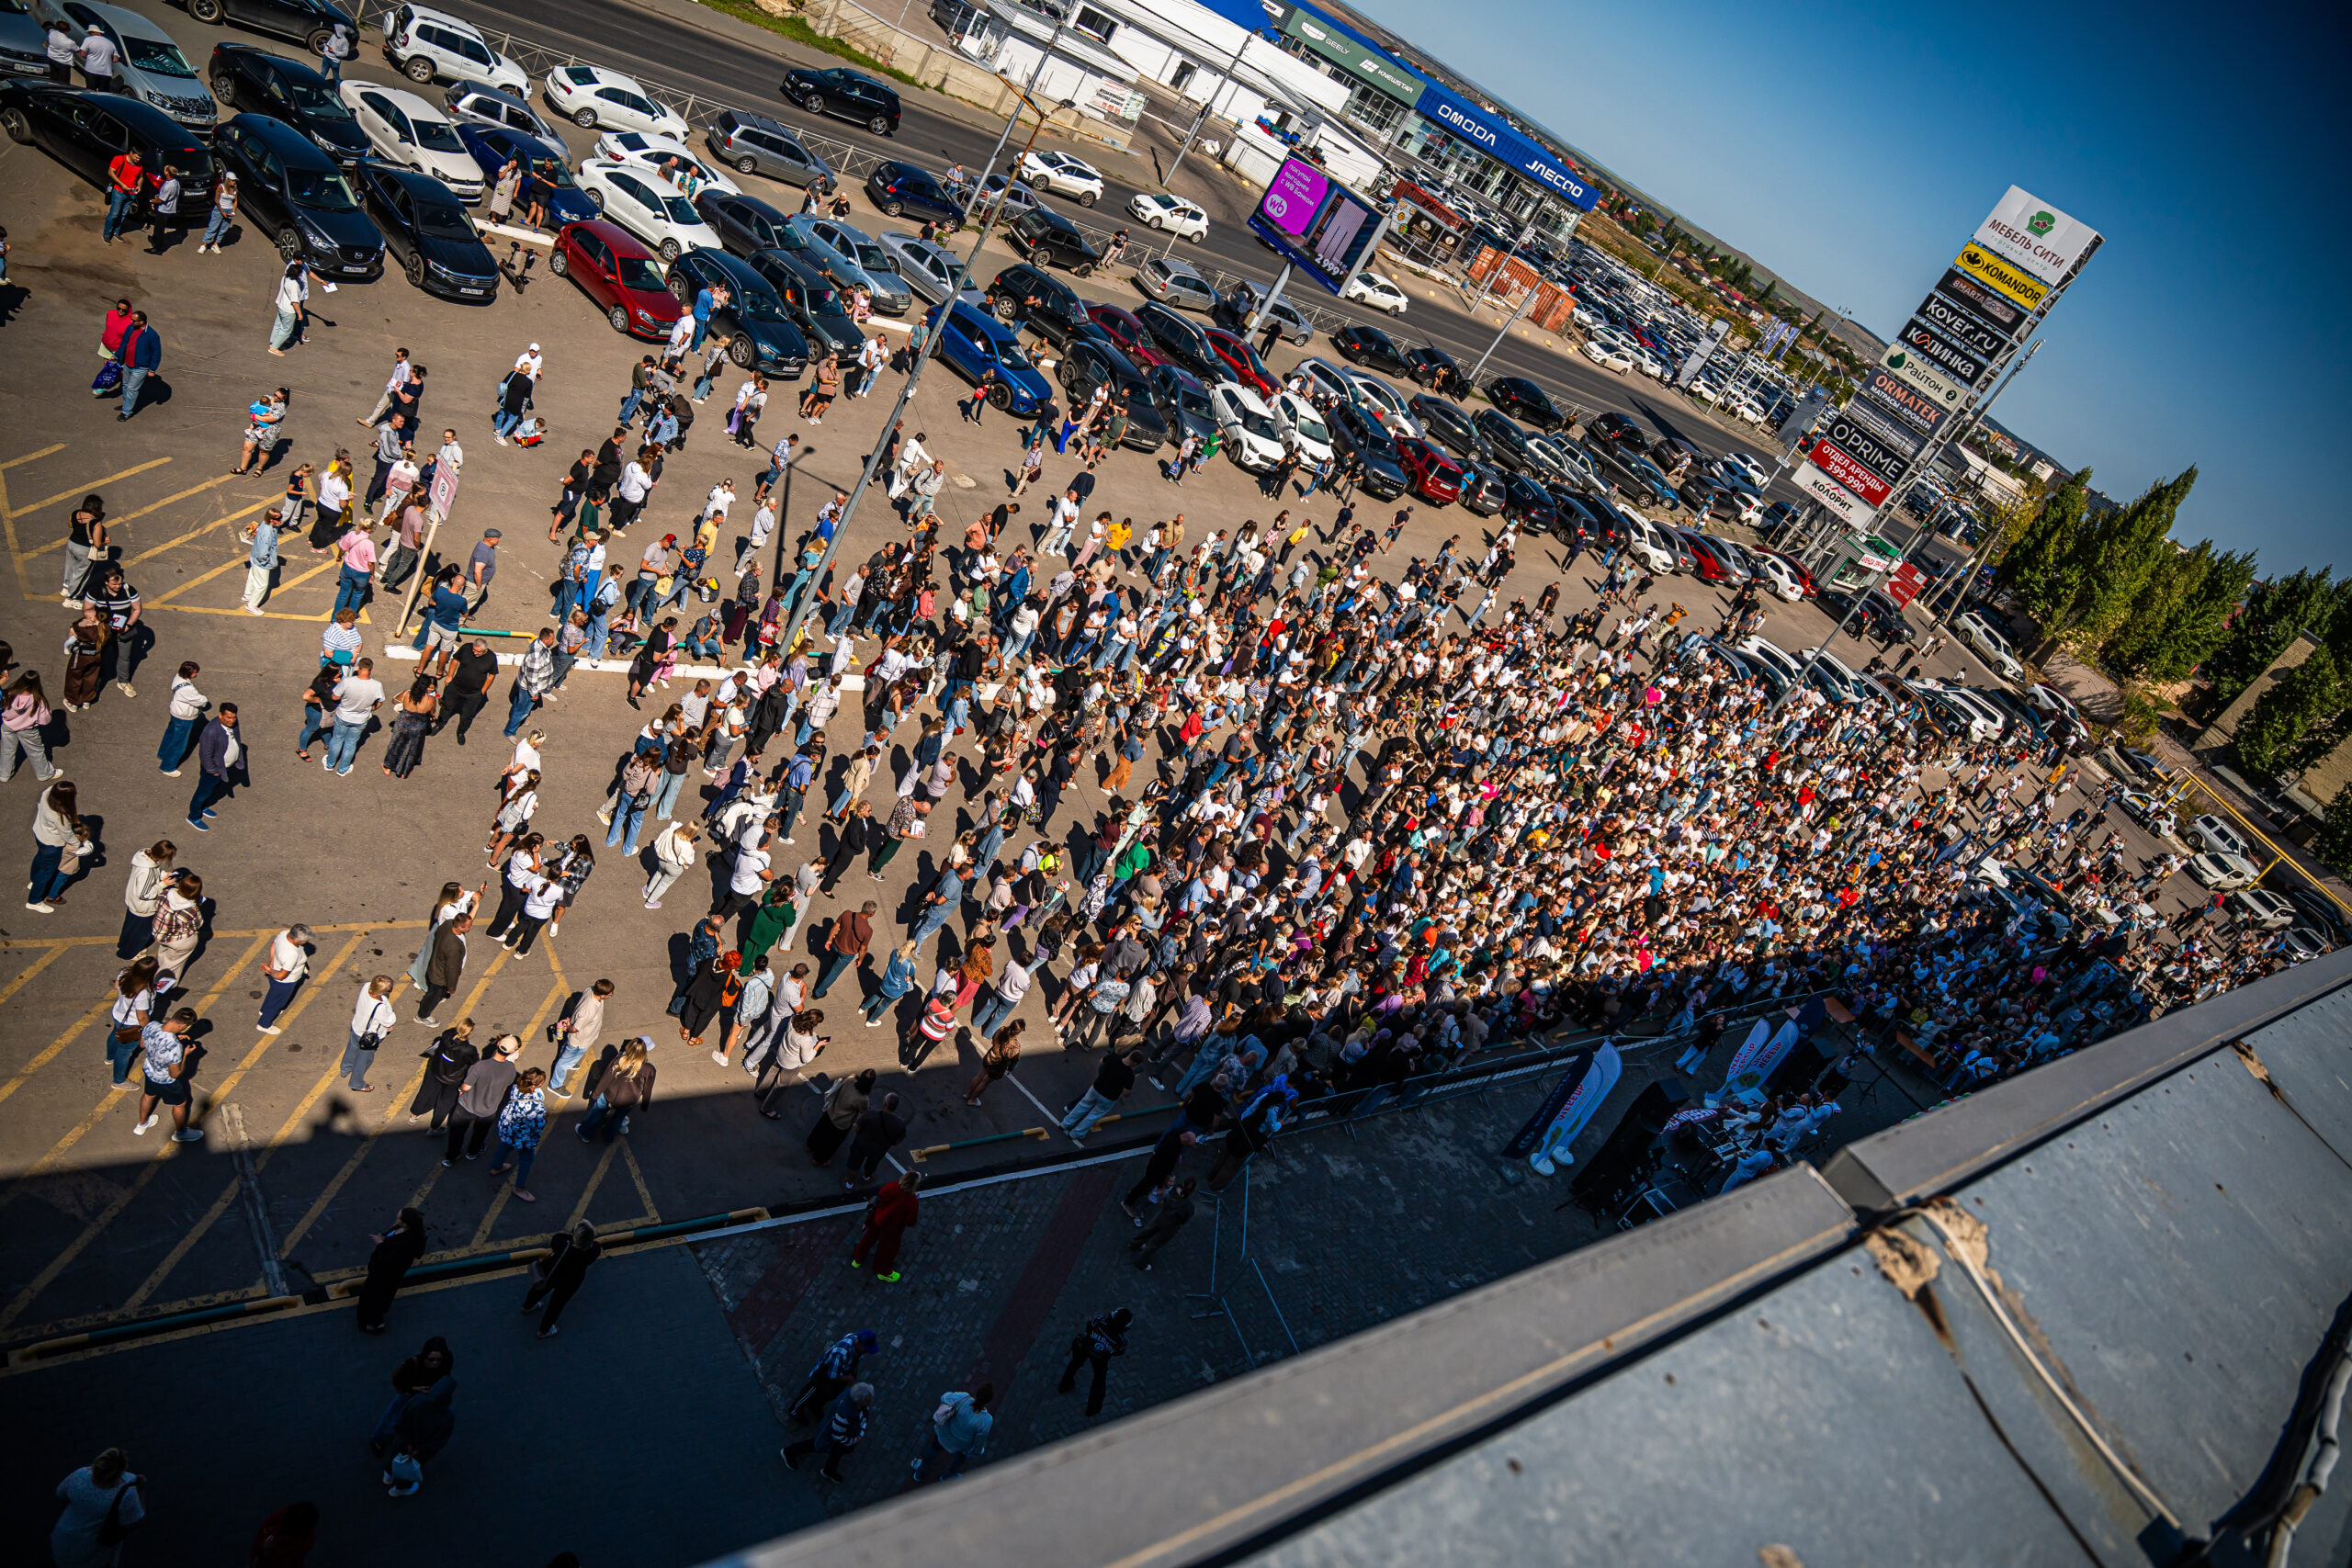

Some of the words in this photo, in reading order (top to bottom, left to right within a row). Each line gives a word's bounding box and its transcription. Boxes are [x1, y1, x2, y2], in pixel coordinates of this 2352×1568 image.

[1326, 38, 1351, 54] GEELY
[1377, 69, 1414, 94] KNEWSTAR
[1283, 172, 1310, 193] выгоднее
[1288, 164, 1312, 184] покупай
[1524, 159, 1583, 198] JAECOO
[1270, 197, 1284, 214] wb
[1284, 180, 1295, 192] WB
[1293, 186, 1315, 207] Банком
[1314, 253, 1324, 265] 2
[1988, 219, 2031, 250] МЕБЕЛЬ
[2032, 244, 2065, 269] СИТИ
[1983, 262, 2041, 303] KOMANDOR
[1952, 280, 1985, 304] 8MARTA
[1984, 298, 2013, 319] GROUP
[1903, 361, 1943, 393] Райтон
[1870, 385, 1901, 409] МАТРАСЫ
[1902, 408, 1932, 431] КРОВАТИ
[1875, 375, 1940, 424] ORMATEK
[1834, 424, 1904, 479] O'PRIME
[1822, 445, 1850, 468] ОТДЕЛ
[1848, 464, 1885, 492] АРЕНДЫ
[1826, 461, 1866, 493] 399-990
[1804, 483, 1826, 502] САЛОН
[1826, 500, 1852, 522] ПЛИТКИ
[1811, 479, 1853, 512] КОЛОРИТ
